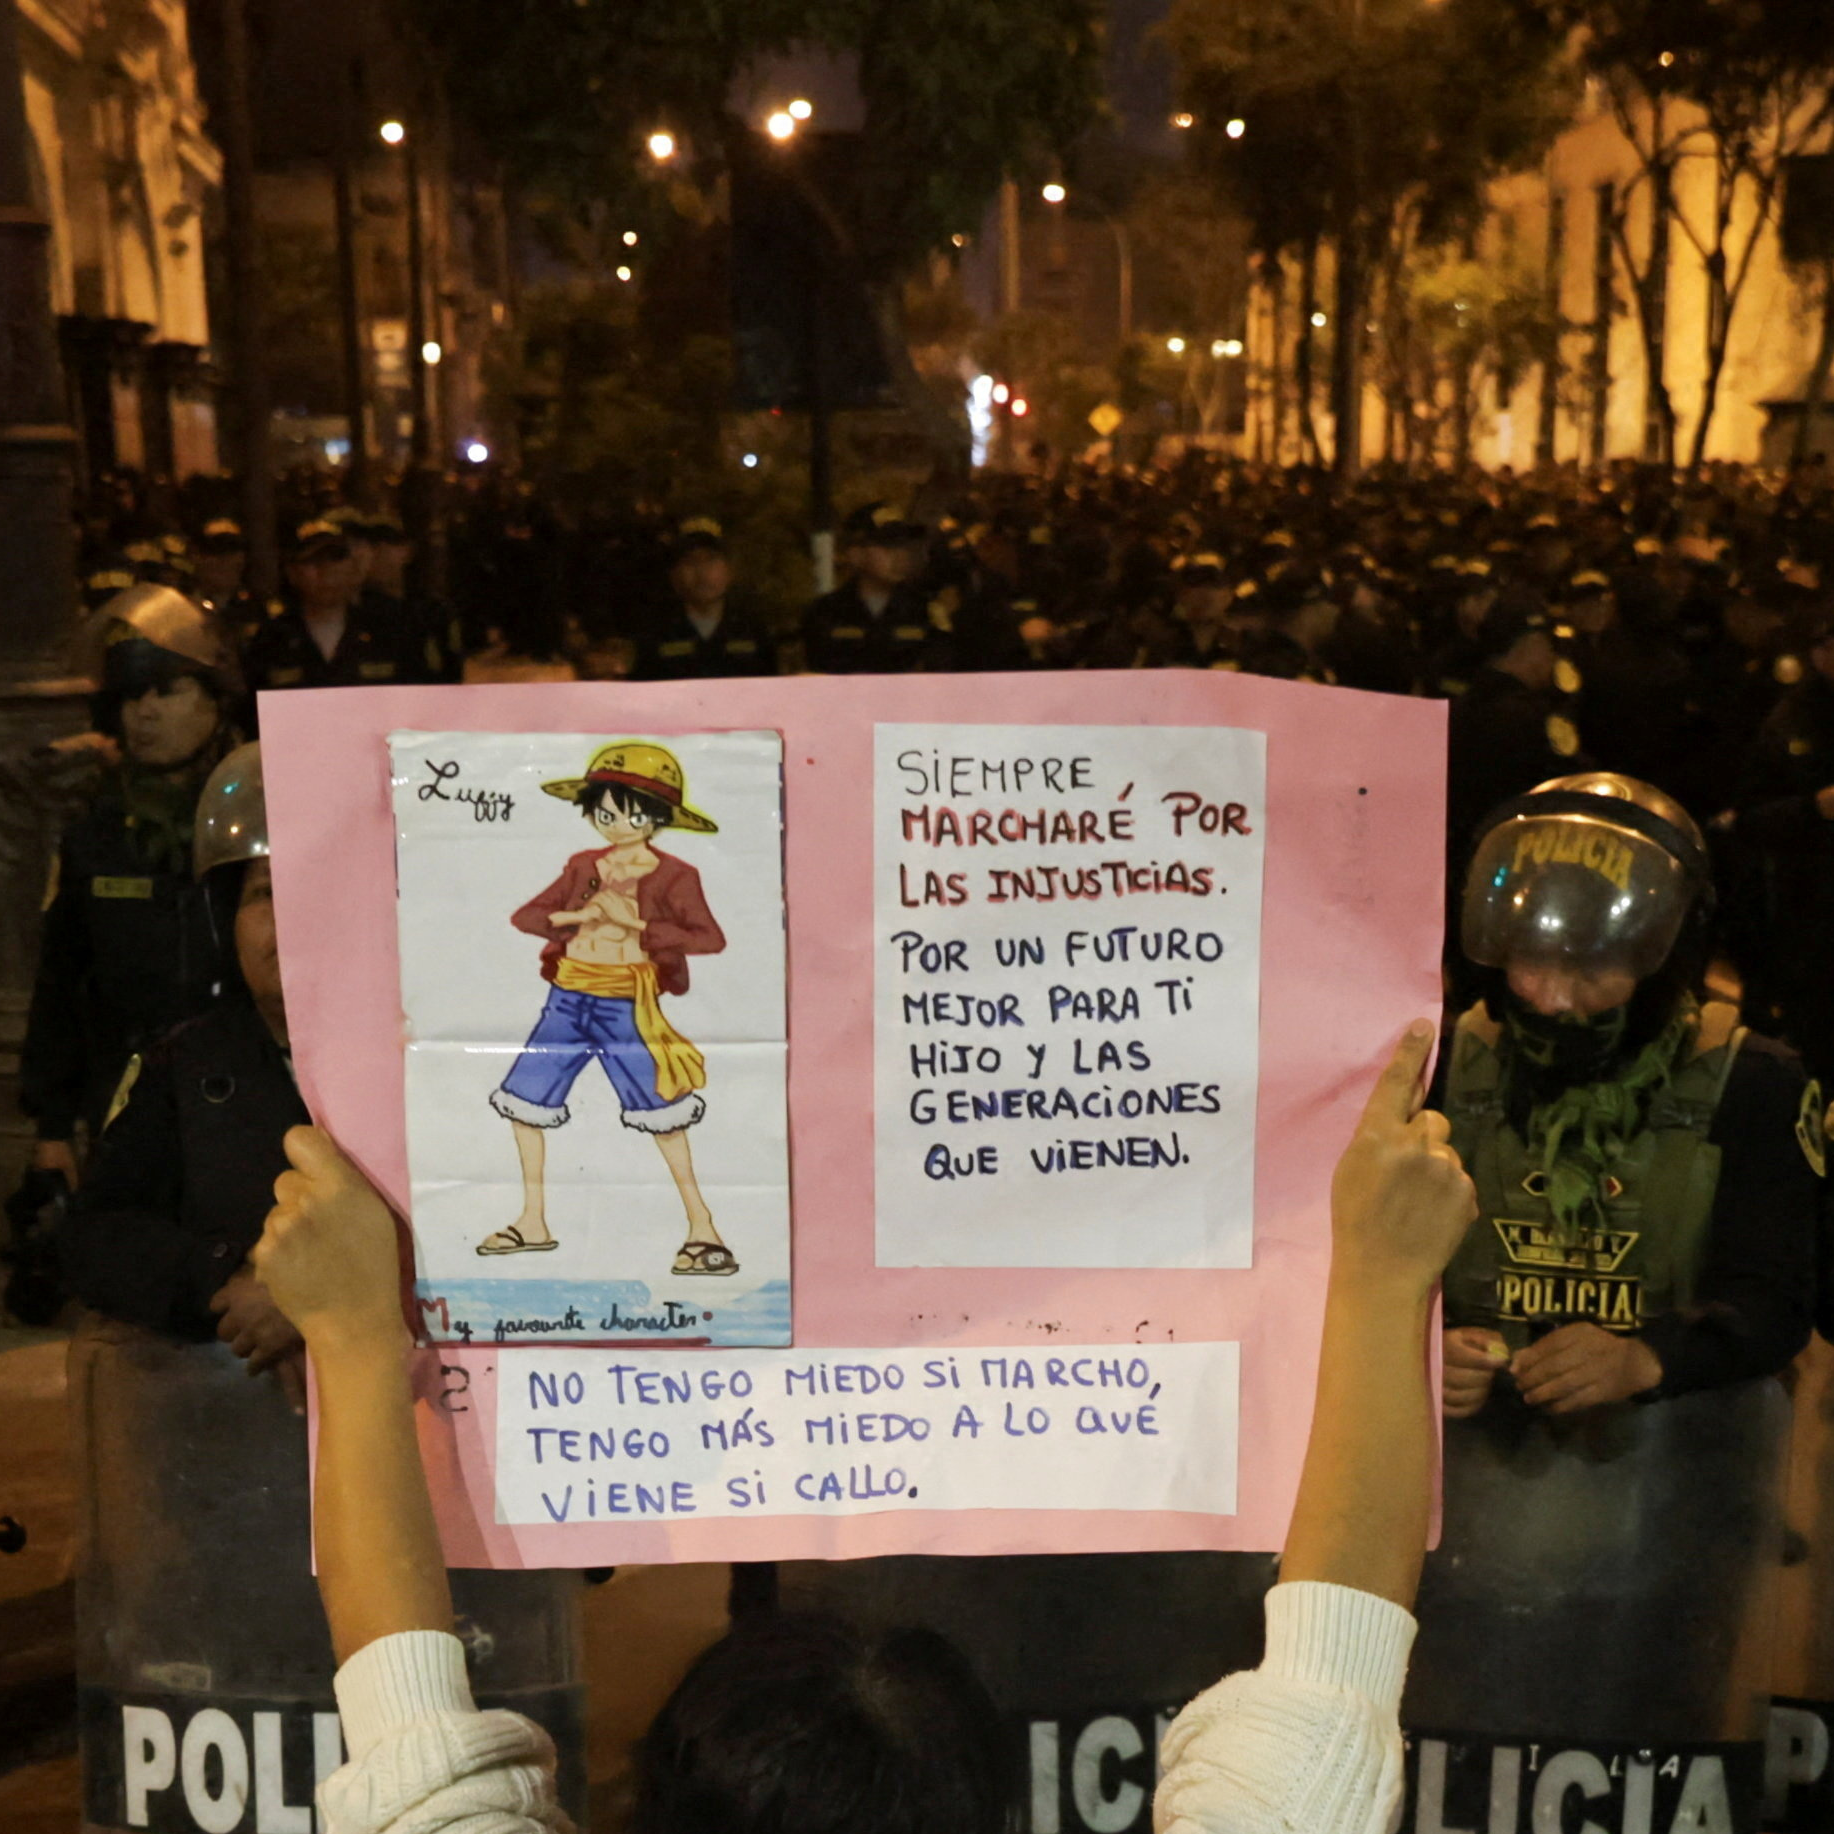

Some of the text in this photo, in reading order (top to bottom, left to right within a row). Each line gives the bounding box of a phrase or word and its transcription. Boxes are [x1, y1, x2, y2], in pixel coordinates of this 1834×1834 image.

[418, 760, 515, 822] Luffy
[901, 782, 1251, 843] MARCHARÉ POR
[900, 865, 968, 906] LAS
[891, 926, 1223, 973] POR UN FUTURO
[903, 992, 1024, 1028] MEJOR
[1049, 985, 1139, 1022] PARA
[1026, 1043, 1047, 1079] Y
[1074, 1038, 1150, 1074] LAS
[924, 1143, 997, 1180] QUE
[416, 1296, 472, 1341] My
[1500, 1273, 1635, 1323] POLICIA
[529, 1371, 583, 1409] NO
[608, 1365, 752, 1404] TENGO
[981, 1359, 1162, 1400] MARCHO,
[527, 1428, 669, 1463] TENGO
[701, 1407, 774, 1450] MÁS
[953, 1405, 979, 1438] A
[1005, 1402, 1049, 1436] LO
[795, 1465, 917, 1501] CALLO.
